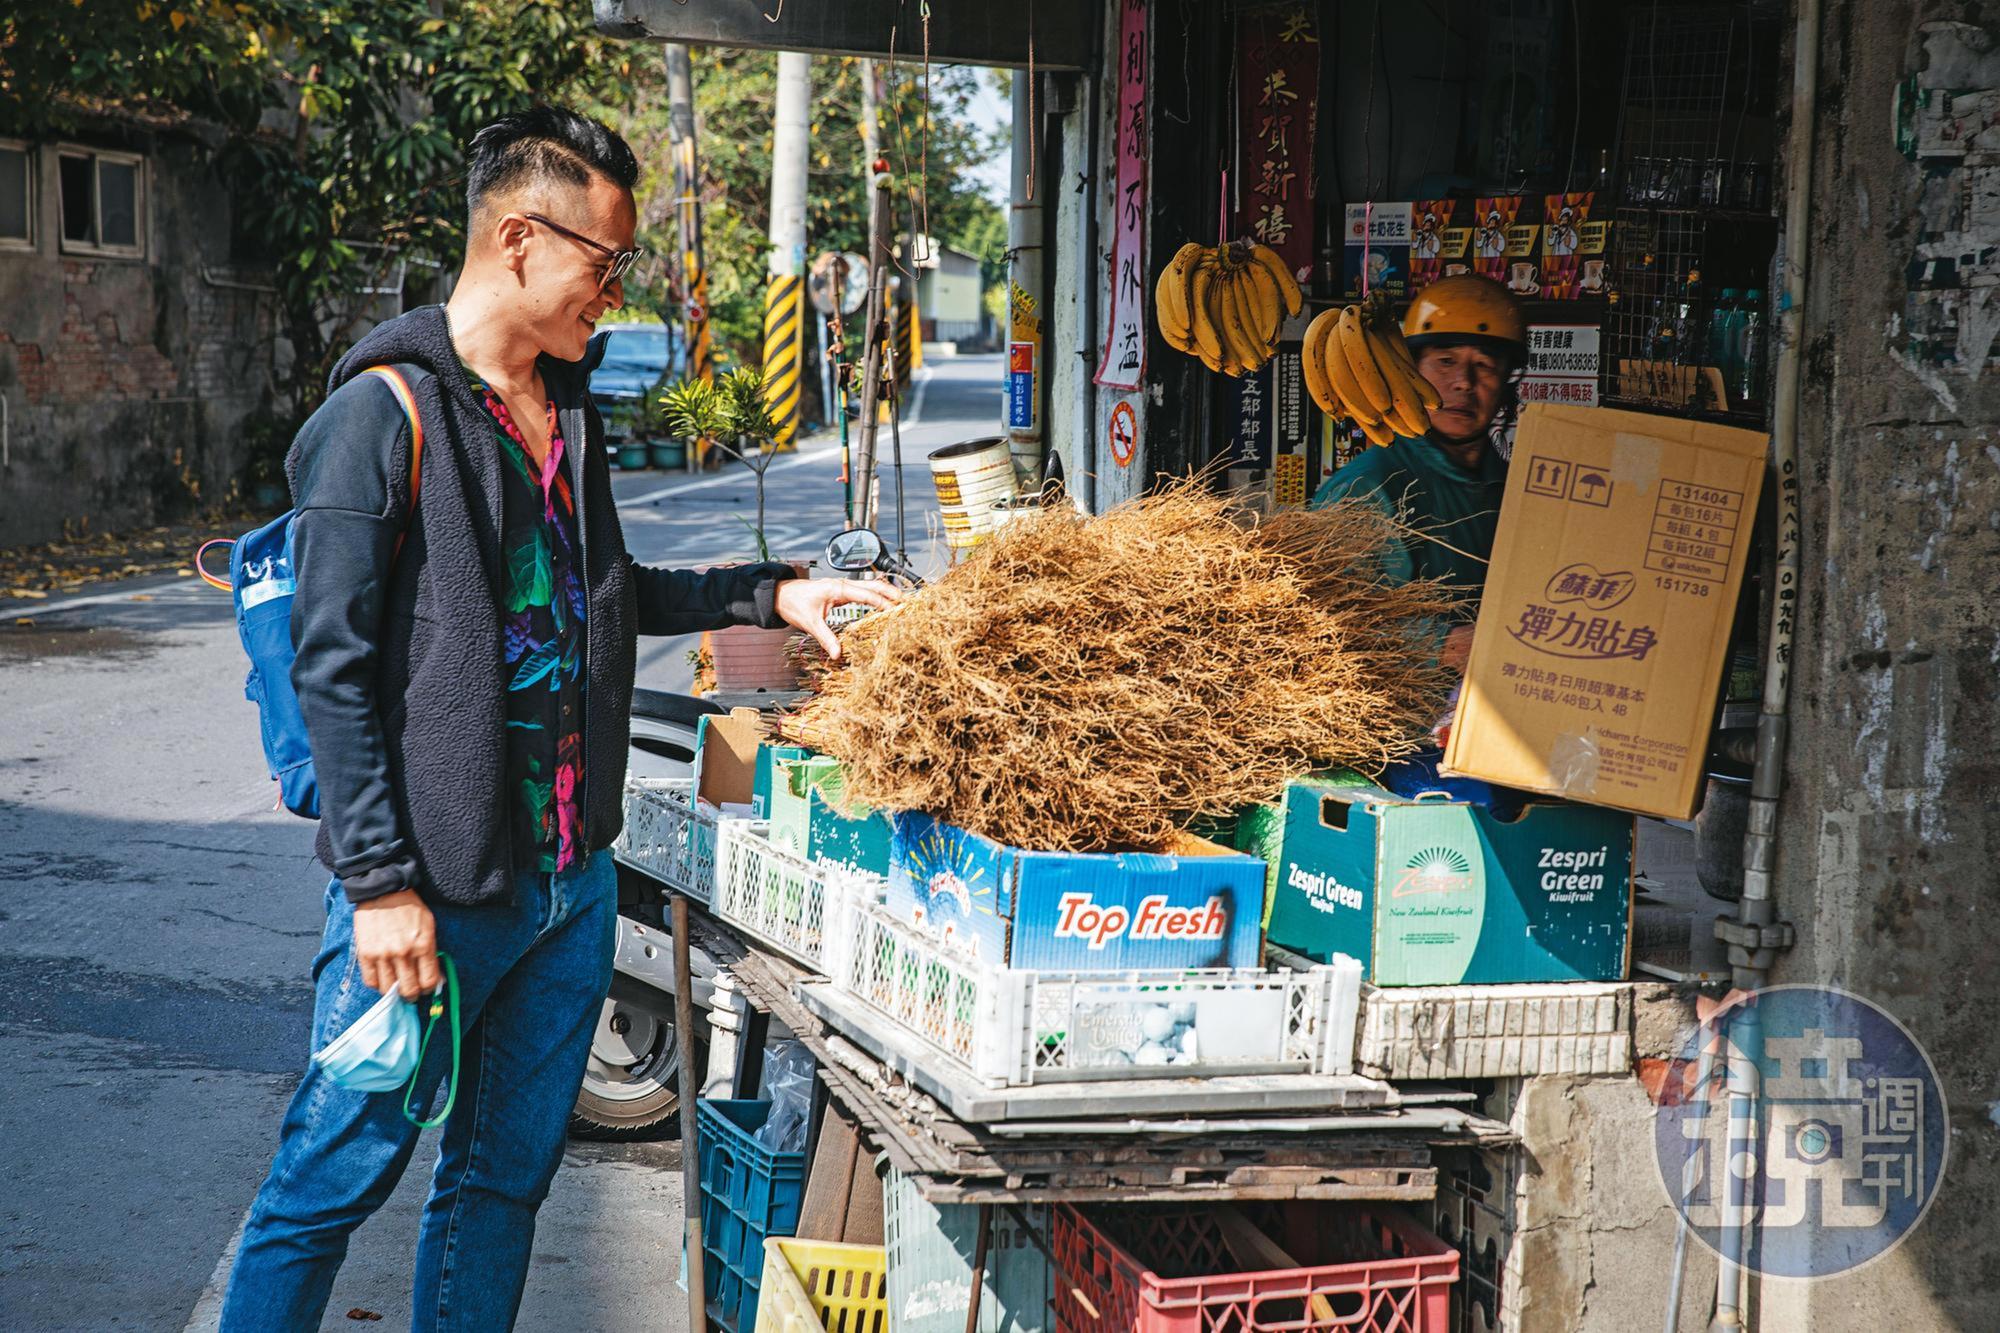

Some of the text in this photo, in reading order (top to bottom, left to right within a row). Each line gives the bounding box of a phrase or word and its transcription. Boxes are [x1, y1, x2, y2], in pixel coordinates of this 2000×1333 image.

[1253, 68, 1299, 246] 恭賀新禧
[1673, 486, 1728, 506] 131404
[1669, 504, 1724, 524] 每包16片
[1662, 538, 1717, 560] 每箱12組
[1555, 573, 1617, 600] 蘇菲
[1655, 576, 1709, 598] 151738
[1518, 604, 1658, 661] 彈力貼身
[1502, 662, 1646, 704] 彈力貼身日用超薄基本
[1633, 734, 1688, 754] Corporation
[1538, 846, 1607, 874] Zespri
[1287, 862, 1363, 911] Zespri Green
[1540, 870, 1604, 891] Green
[1549, 891, 1594, 904] Kiwifruit
[1060, 896, 1227, 945] Top Fresh
[1389, 906, 1474, 918] New Zealand Kiwifruit
